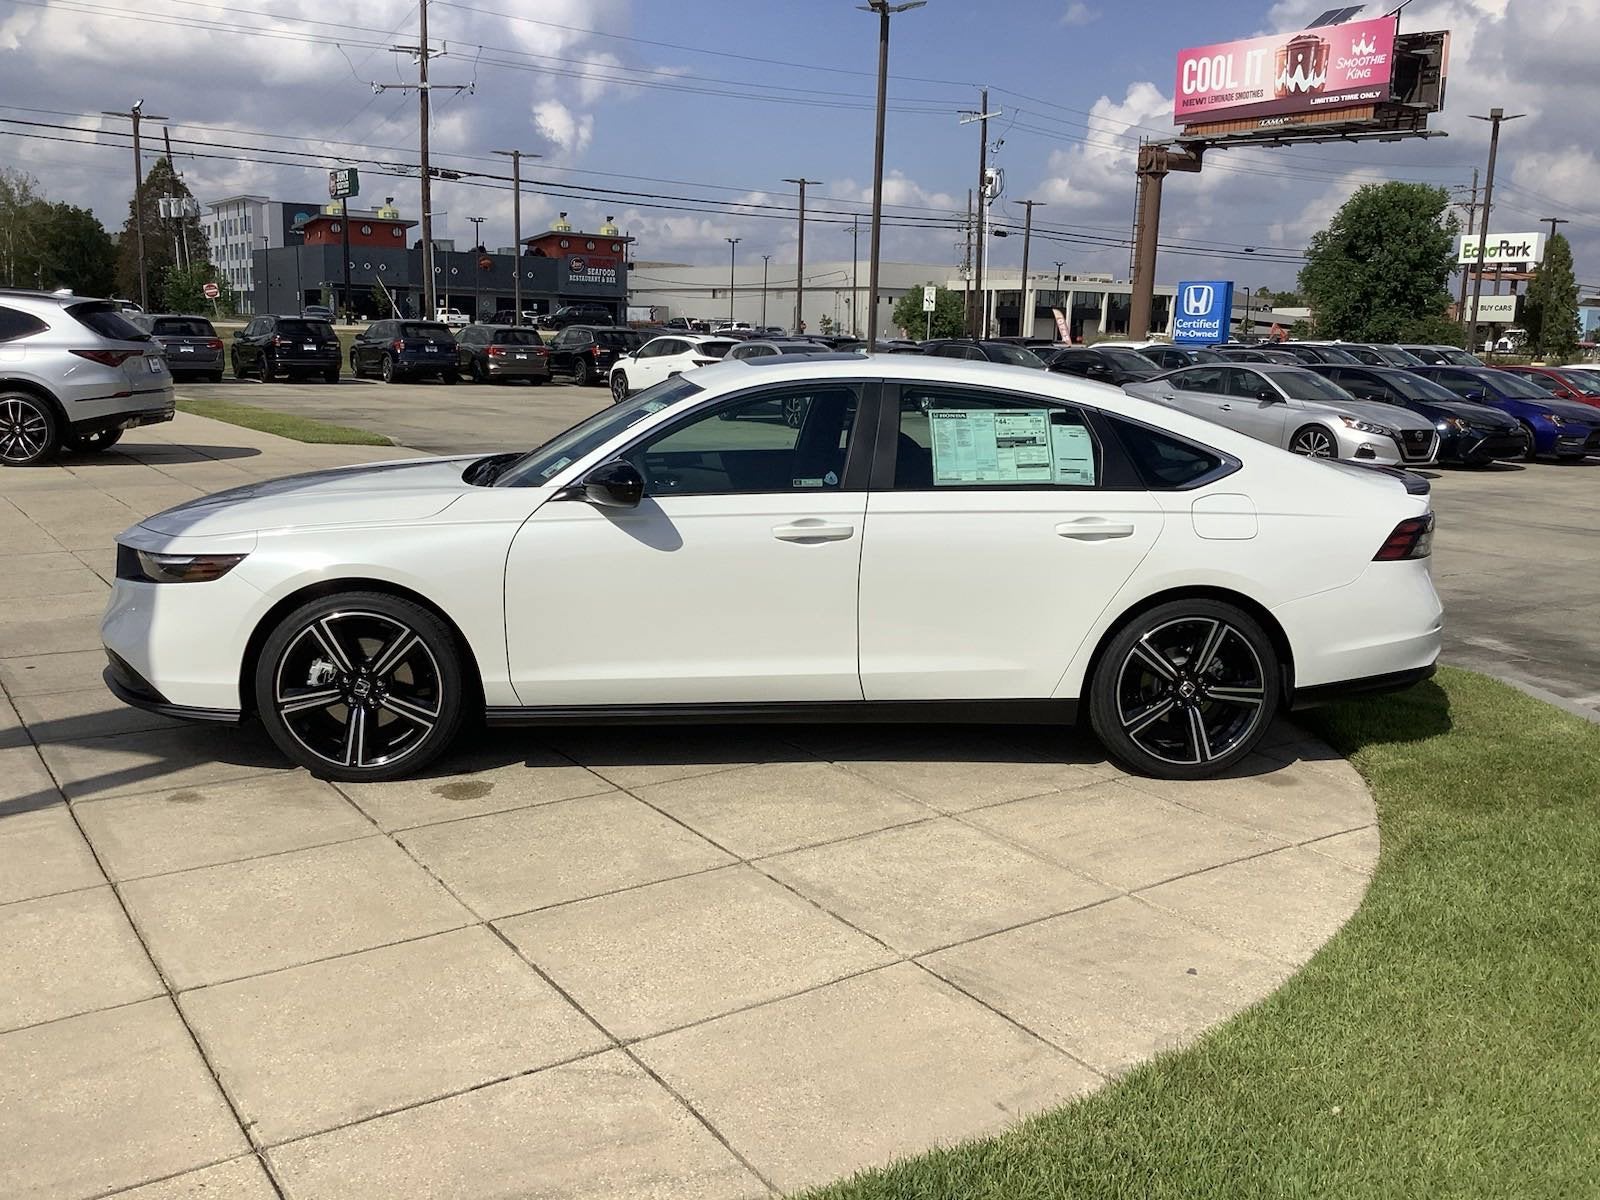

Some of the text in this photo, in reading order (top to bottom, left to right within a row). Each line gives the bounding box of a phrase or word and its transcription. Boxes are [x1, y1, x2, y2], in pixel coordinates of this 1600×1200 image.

[1336, 54, 1386, 69] SMOOTHIE
[1182, 49, 1269, 95] COOL IT
[1182, 89, 1264, 107] NEW! LEMONADE SMOOTHIES
[1310, 91, 1381, 105] LIMITED TIME ONLY
[588, 268, 616, 276] SEAFOOD
[1176, 319, 1219, 329] Certified
[1175, 329, 1219, 338] Pre-Owned
